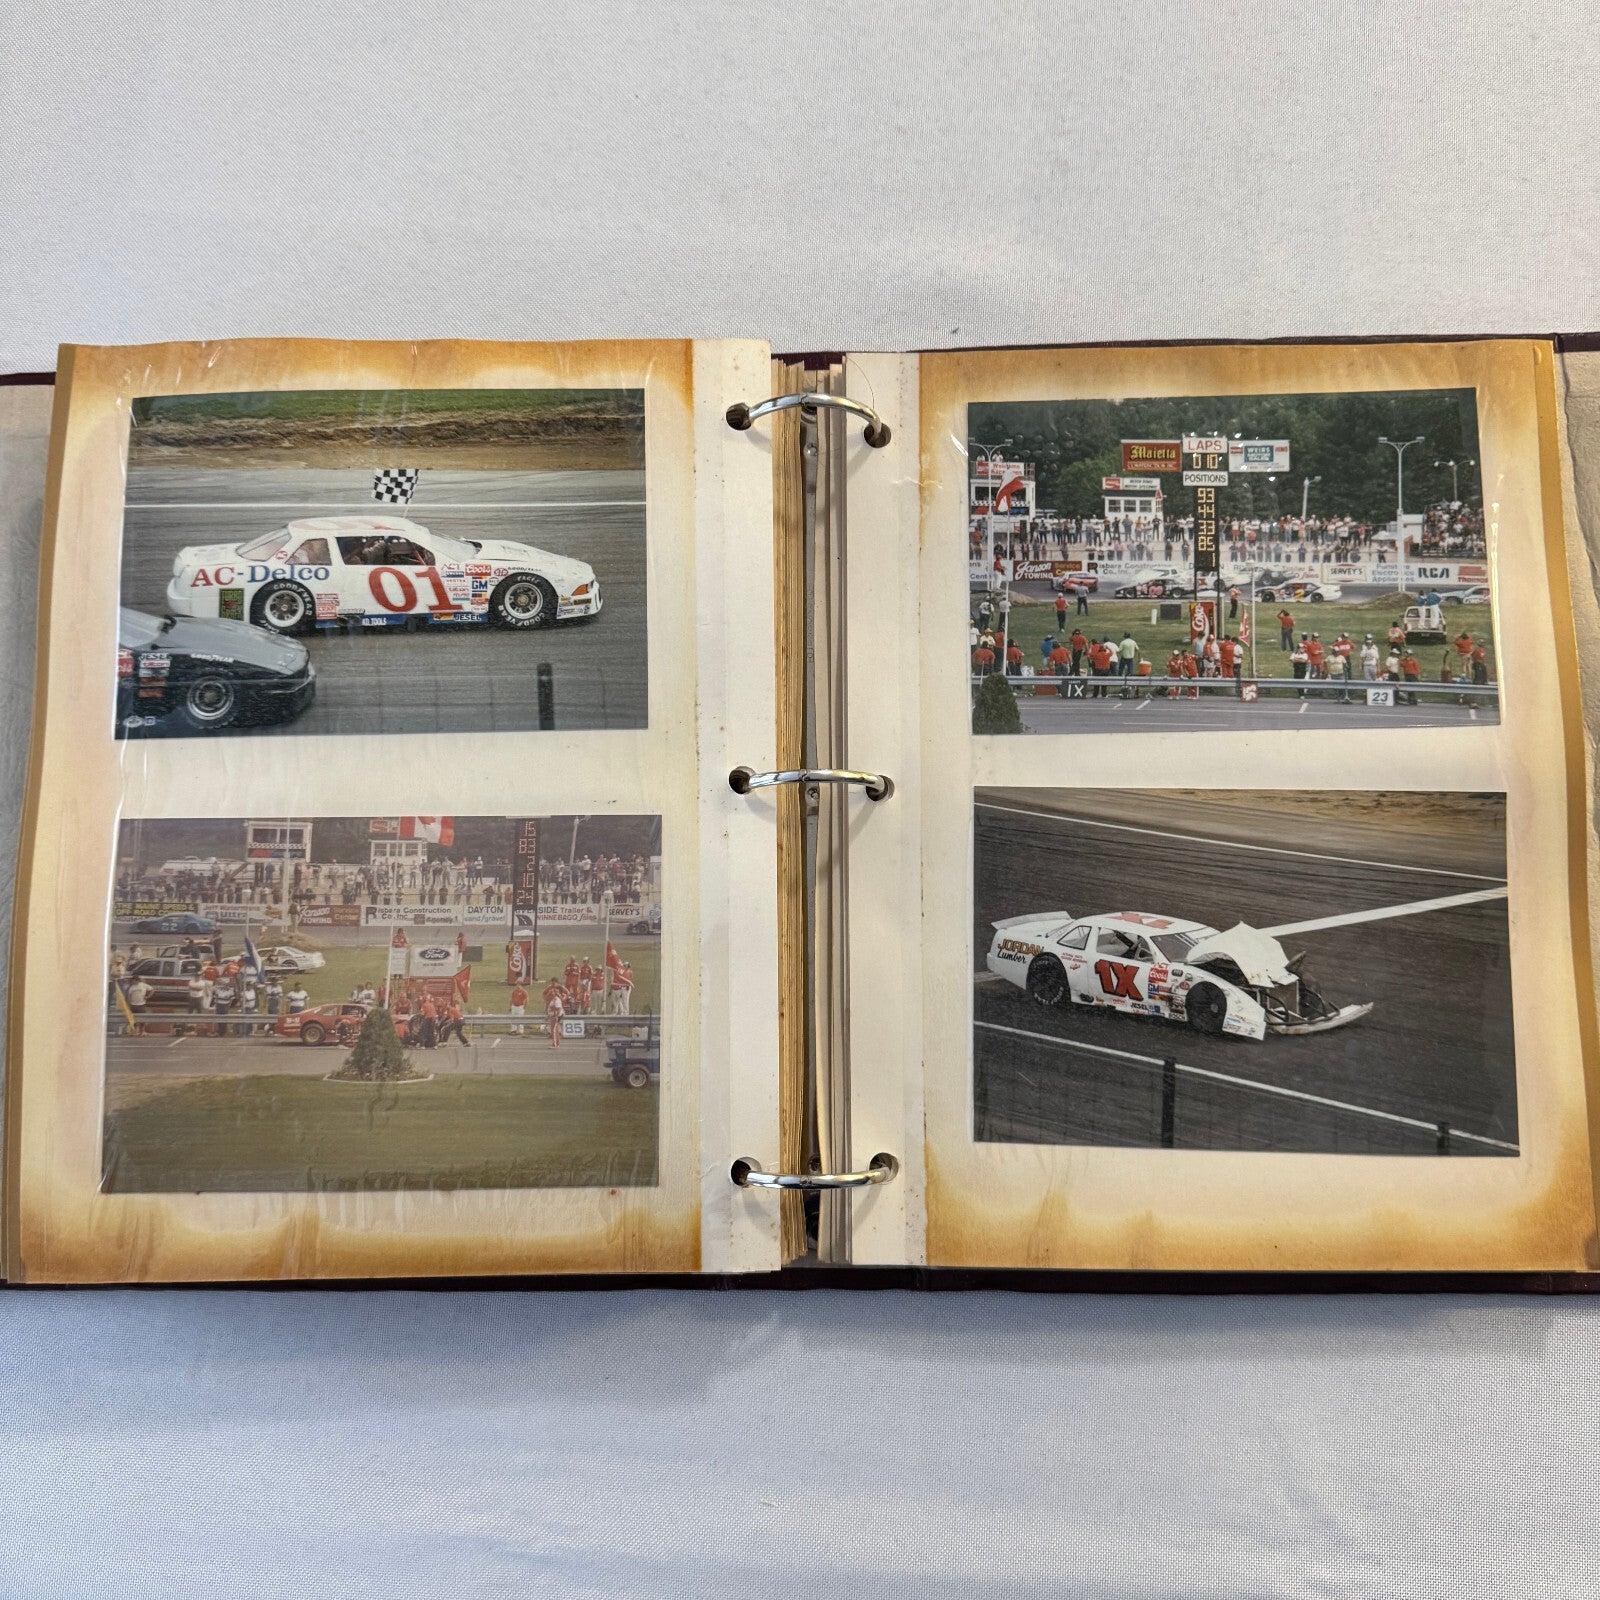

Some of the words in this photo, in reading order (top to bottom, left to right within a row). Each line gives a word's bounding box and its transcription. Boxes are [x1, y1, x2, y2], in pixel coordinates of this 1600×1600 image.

[1187, 439, 1223, 450] LAPS
[1184, 474, 1227, 483] POSITIONS
[1197, 488, 1215, 503] 93
[1197, 504, 1215, 518] 44
[1198, 520, 1215, 534] 33
[1198, 536, 1215, 551] 85
[1212, 552, 1216, 568] 1
[190, 563, 330, 587] AC-Delco
[1418, 567, 1450, 579] RCA
[368, 566, 464, 613] 01
[471, 580, 488, 590] GM
[455, 613, 482, 621] JESEL
[1372, 691, 1388, 702] 23
[467, 906, 504, 914] DAYTON
[424, 949, 446, 959] Ford
[1000, 939, 1042, 956] JORDAN
[997, 949, 1027, 964] Lumber
[1094, 959, 1144, 1001] 1X
[565, 1023, 583, 1034] 85
